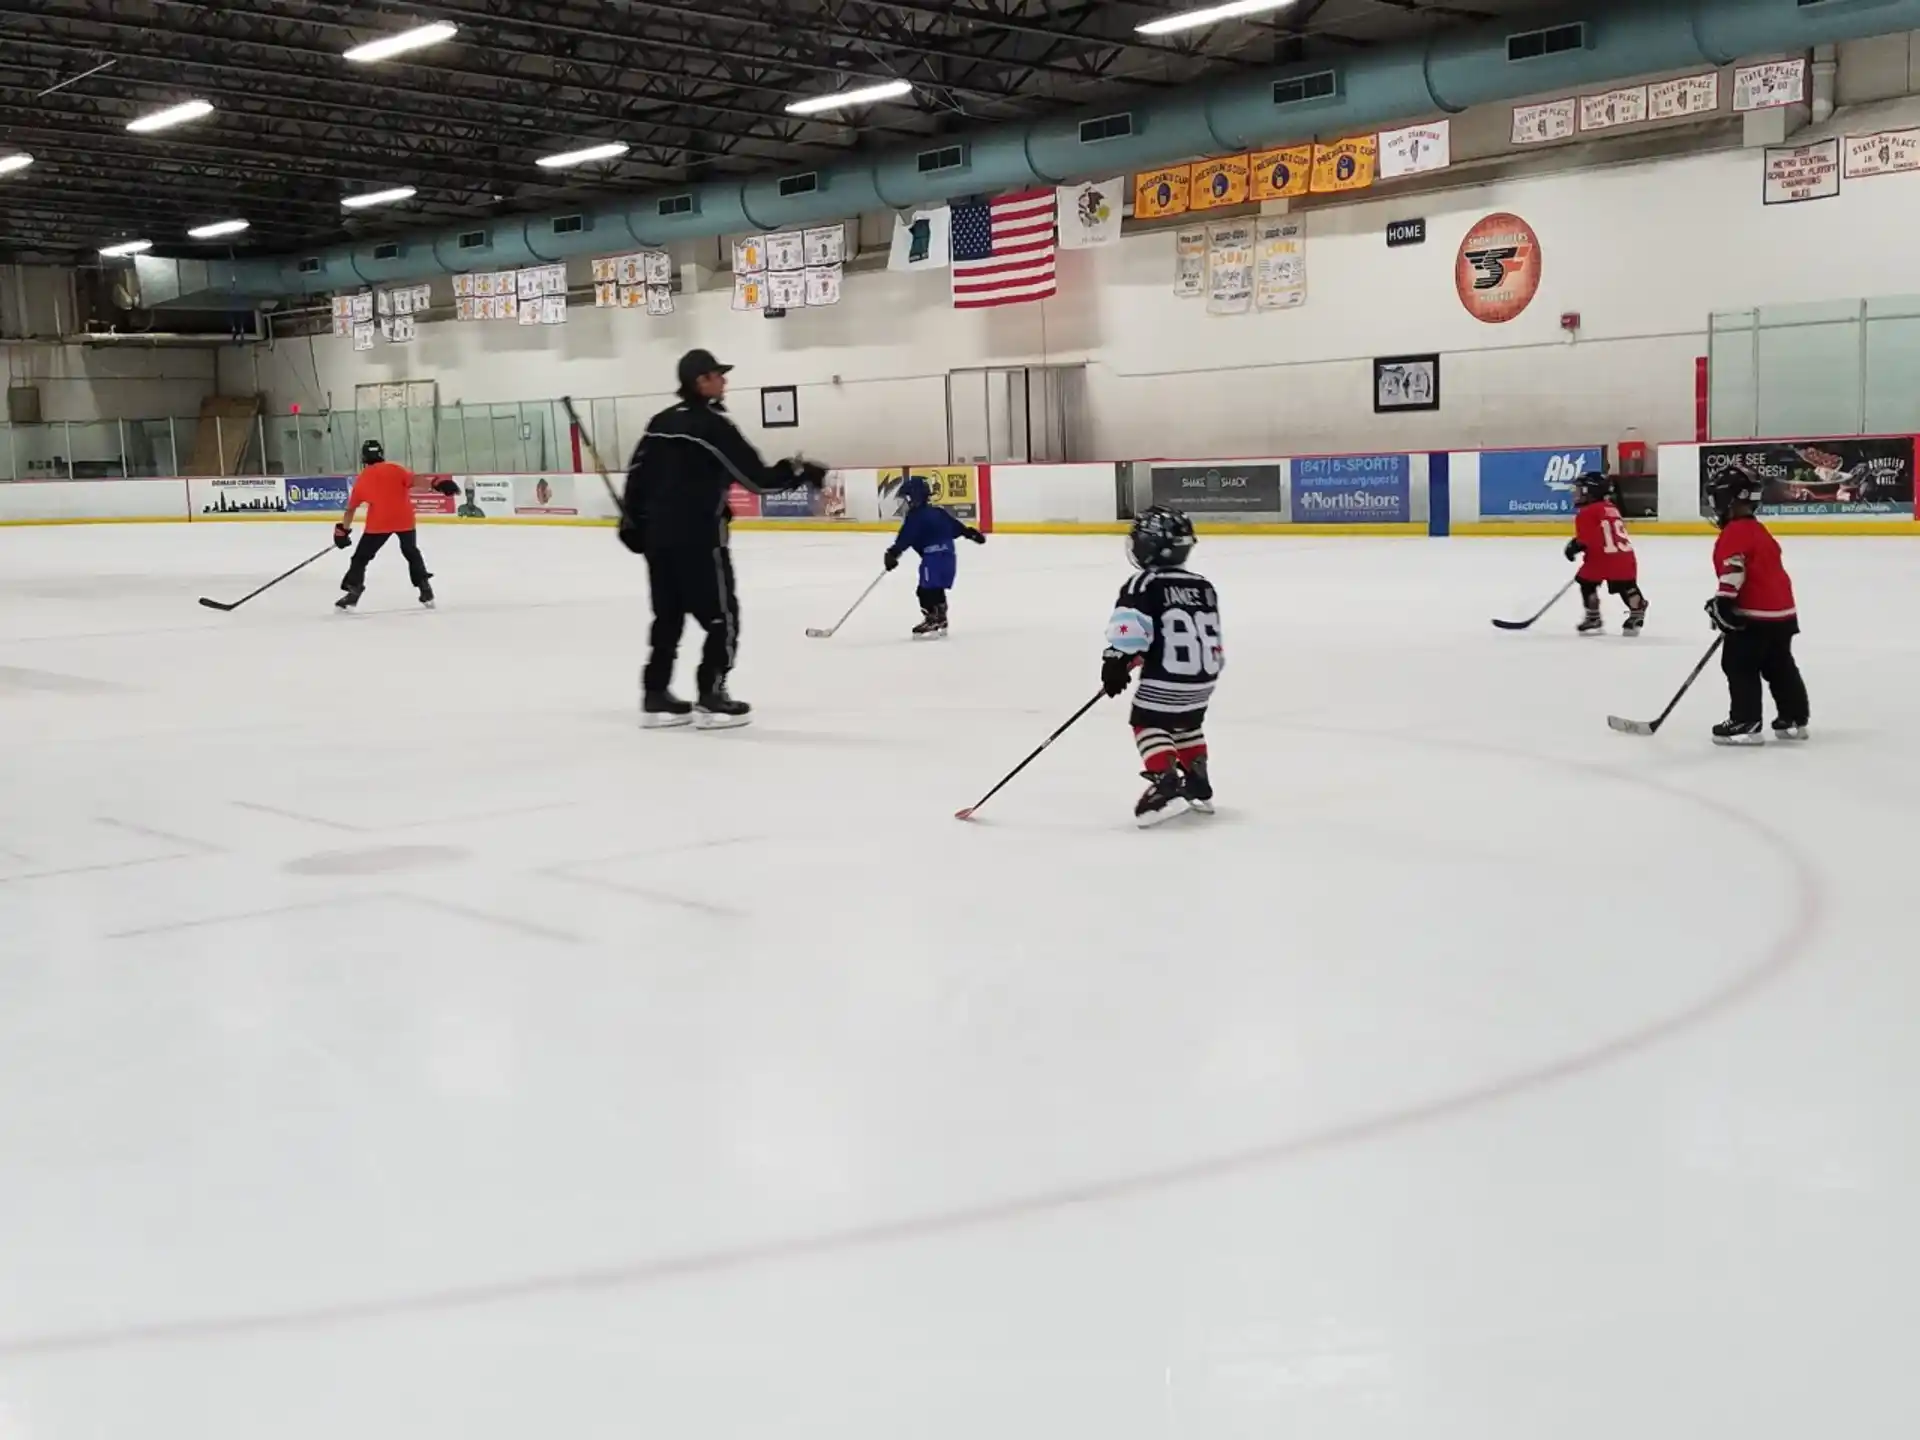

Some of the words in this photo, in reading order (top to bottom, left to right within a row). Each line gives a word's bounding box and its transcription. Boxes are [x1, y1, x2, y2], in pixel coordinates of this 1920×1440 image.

[1776, 66, 1799, 77] PLACE
[1852, 139, 1876, 155] STATE
[1891, 137, 1916, 148] PLACE
[1389, 225, 1421, 241] HOME
[1544, 453, 1586, 482] Abt
[1707, 454, 1742, 467] COME
[1745, 453, 1766, 465] SEE
[1753, 464, 1787, 477] RESH
[1182, 478, 1206, 487] SHAKE
[1221, 477, 1248, 487] SHACK
[1312, 491, 1399, 509] NorthShore
[1509, 500, 1558, 511] Electronics
[1560, 500, 1568, 510] &
[1163, 586, 1203, 607] JAMES
